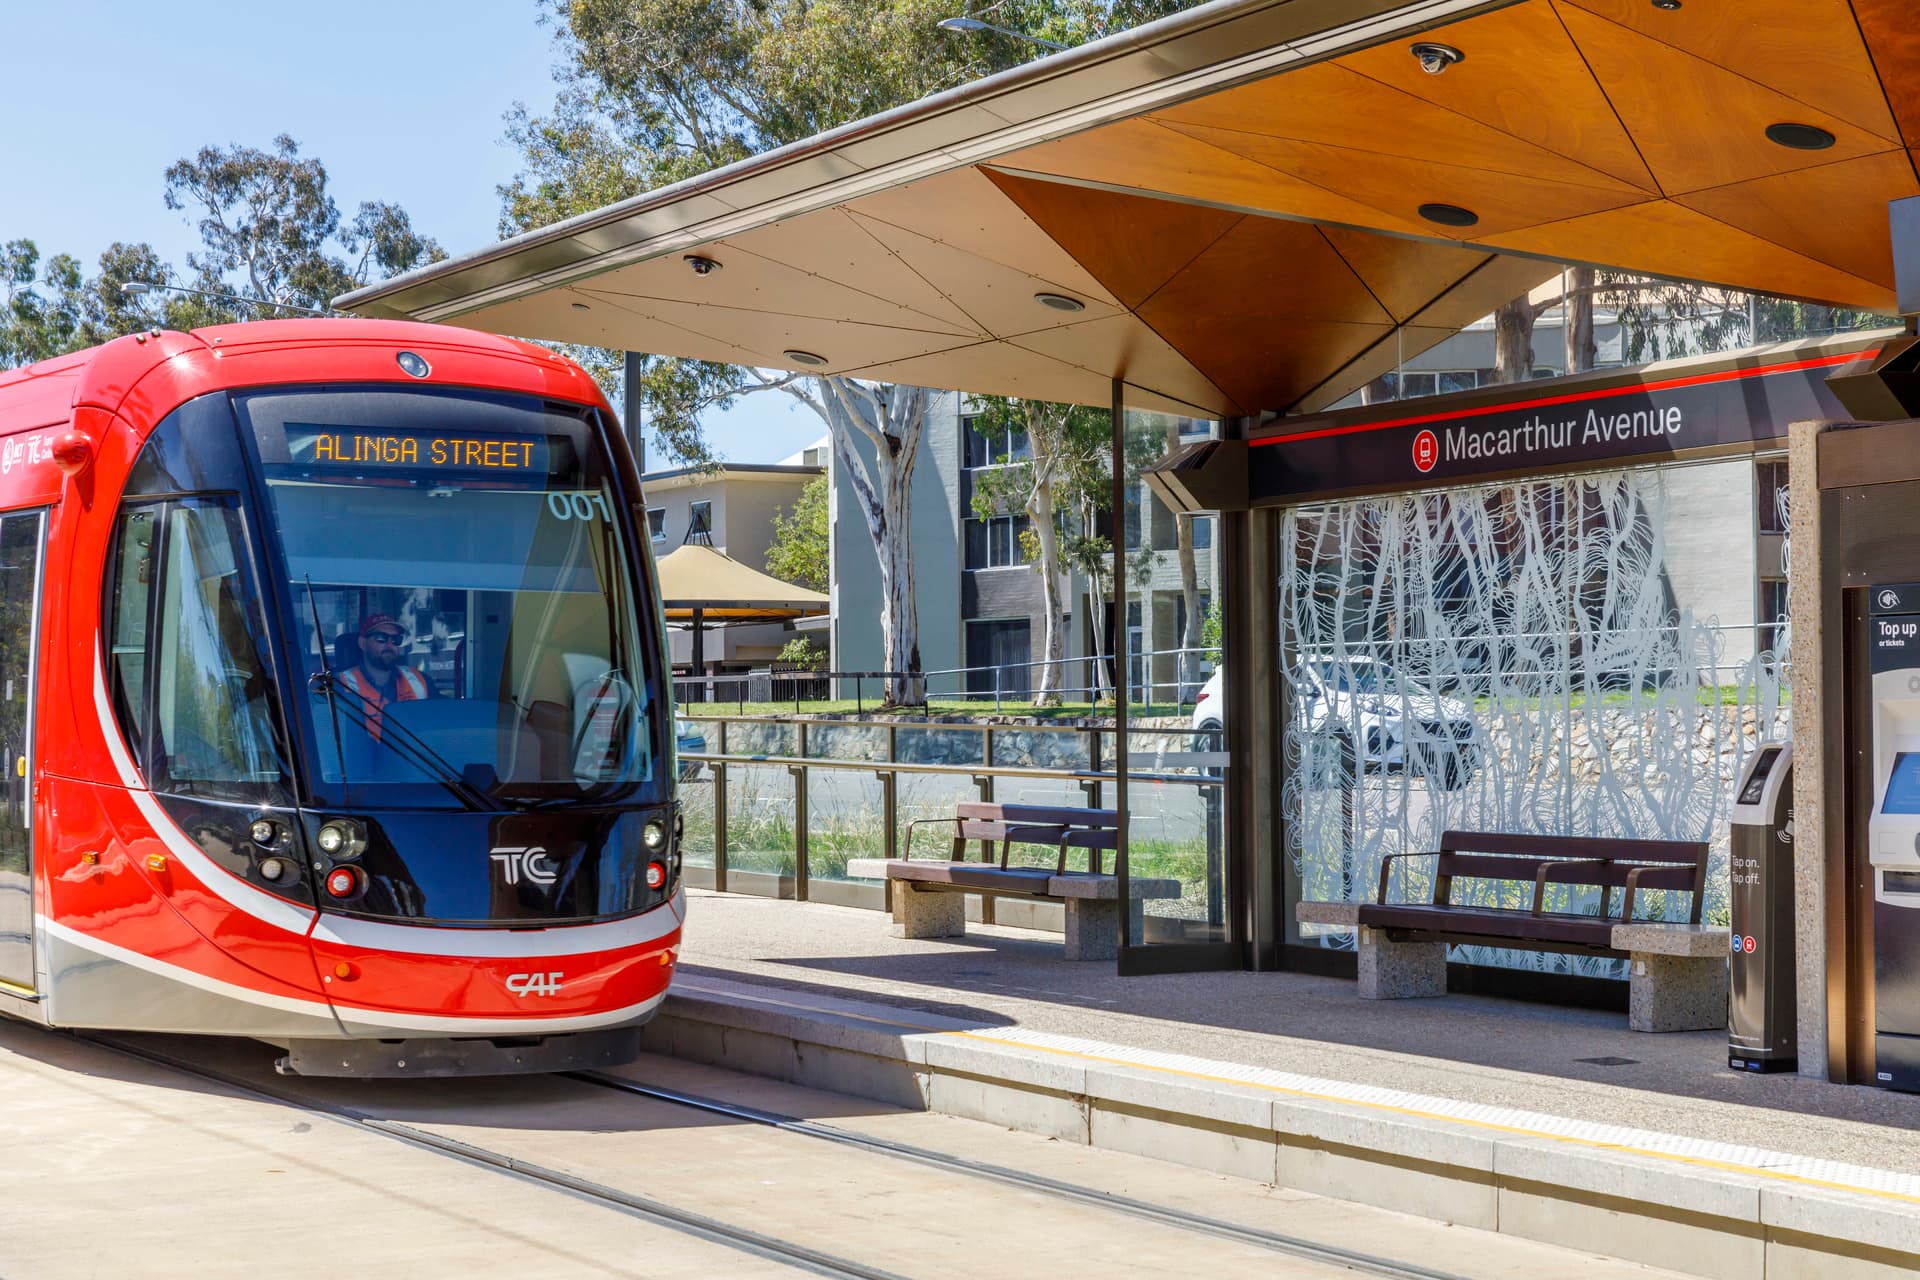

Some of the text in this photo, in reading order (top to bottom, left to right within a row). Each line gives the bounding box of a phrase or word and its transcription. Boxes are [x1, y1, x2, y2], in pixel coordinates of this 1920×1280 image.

[1445, 406, 1681, 461] Macarthur Avenue
[315, 434, 535, 467] ALINGA STREET
[547, 492, 611, 522] 001
[1879, 621, 1917, 638] Top up
[490, 847, 557, 885] TC
[1745, 858, 1760, 868] on.
[1745, 872, 1760, 885] off.
[506, 972, 564, 998] CAF
